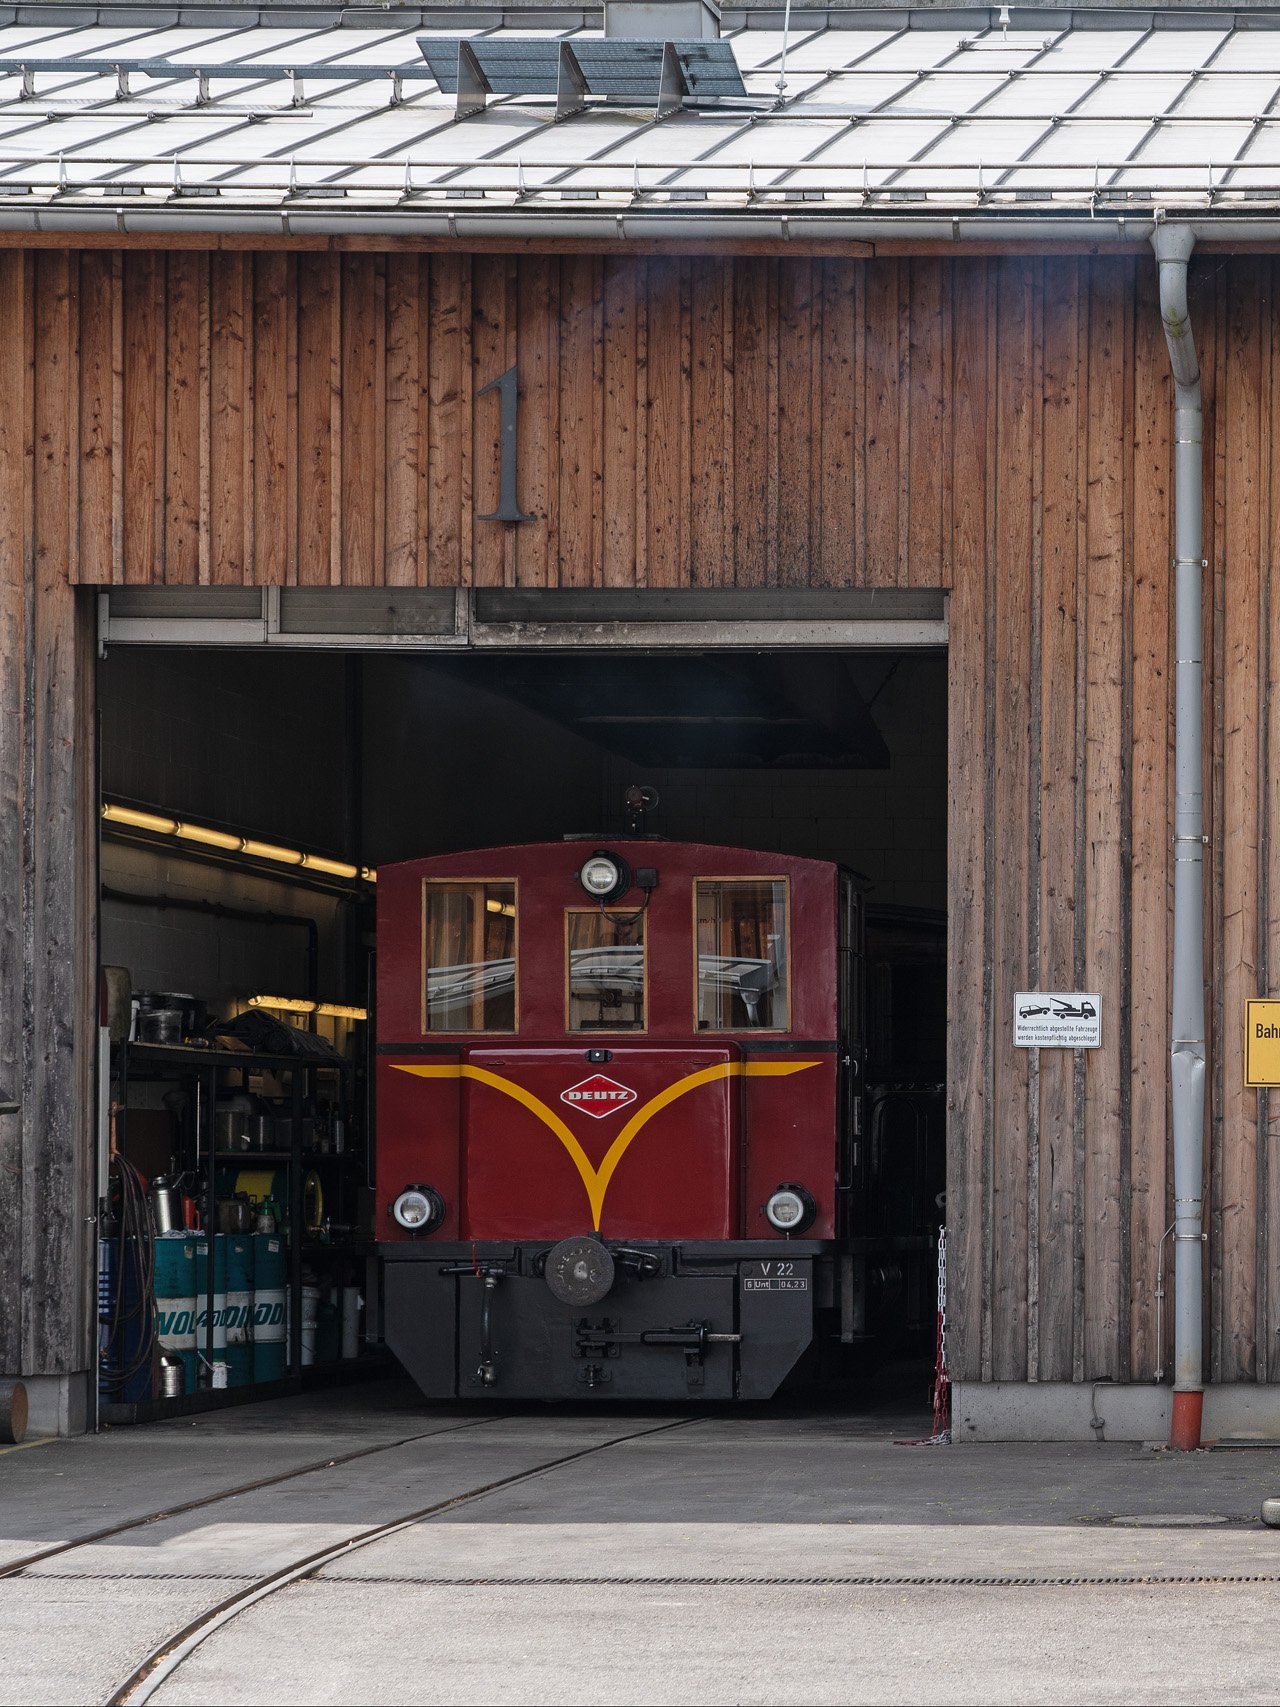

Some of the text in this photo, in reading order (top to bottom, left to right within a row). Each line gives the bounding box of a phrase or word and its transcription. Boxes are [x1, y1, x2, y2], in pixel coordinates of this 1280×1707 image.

[477, 365, 538, 521] 1
[1049, 1025, 1074, 1034] abgestellte
[1075, 1025, 1098, 1034] Fahrzeuge
[1034, 1034, 1067, 1042] kostenpflichtig
[1068, 1034, 1097, 1043] abgeschleppt
[568, 1091, 628, 1100] DEUTZ
[760, 1262, 794, 1276] V 22
